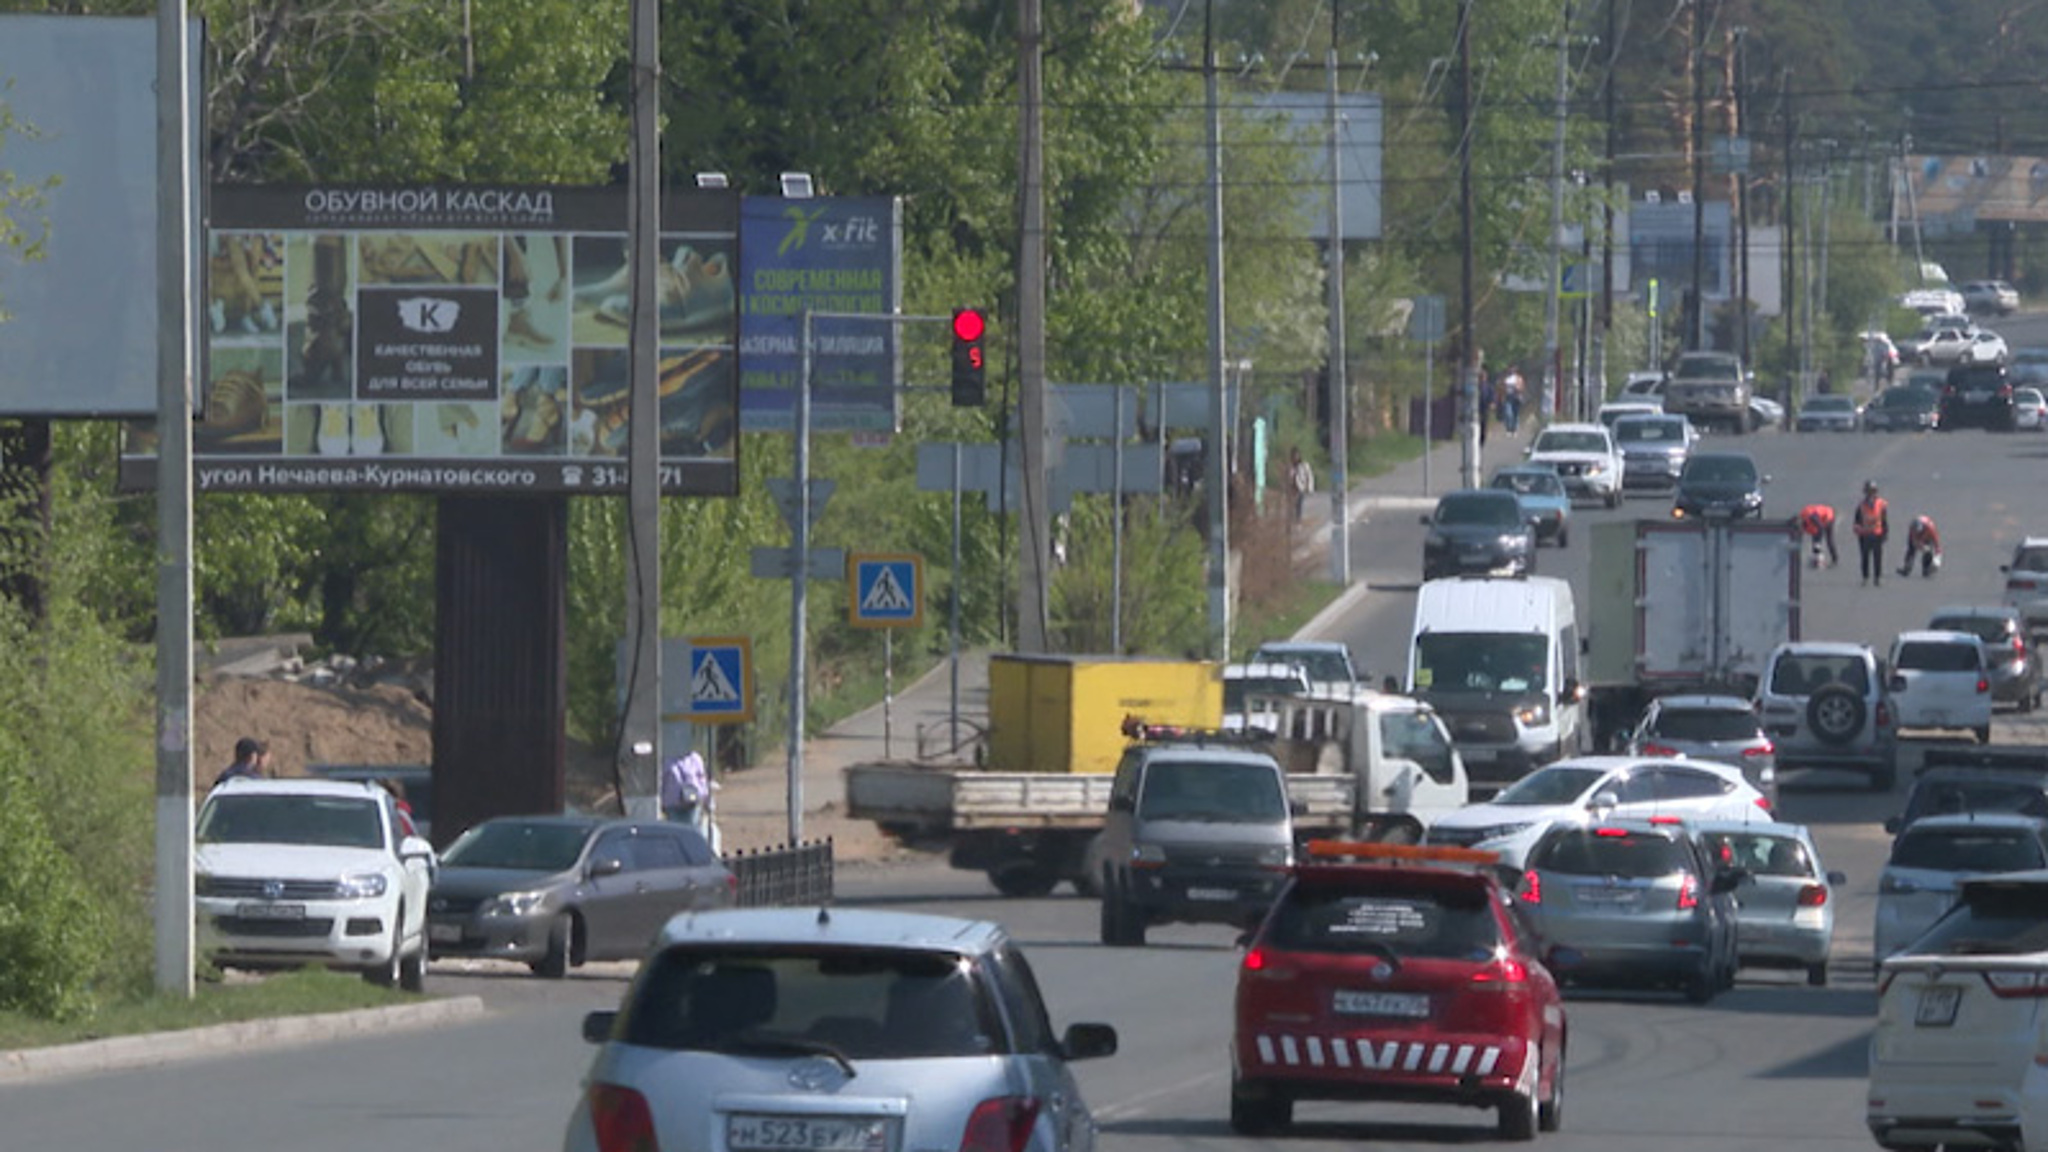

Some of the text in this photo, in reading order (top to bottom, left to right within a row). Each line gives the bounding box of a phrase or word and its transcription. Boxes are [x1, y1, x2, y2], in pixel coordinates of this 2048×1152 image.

[304, 186, 554, 215] ОБУВНОЙ КАСКАД
[754, 269, 882, 291] СОВРЕМЕННАЯ
[420, 302, 440, 327] К
[374, 343, 483, 357] КАЧЕСТВЕННАЯ
[404, 359, 453, 374] ОБУВЬ
[368, 375, 489, 391] ДЛЯ ВСЕЙ СЕМЬИ
[199, 469, 252, 488] угол
[258, 465, 536, 487] Нечаева-Курнатовского
